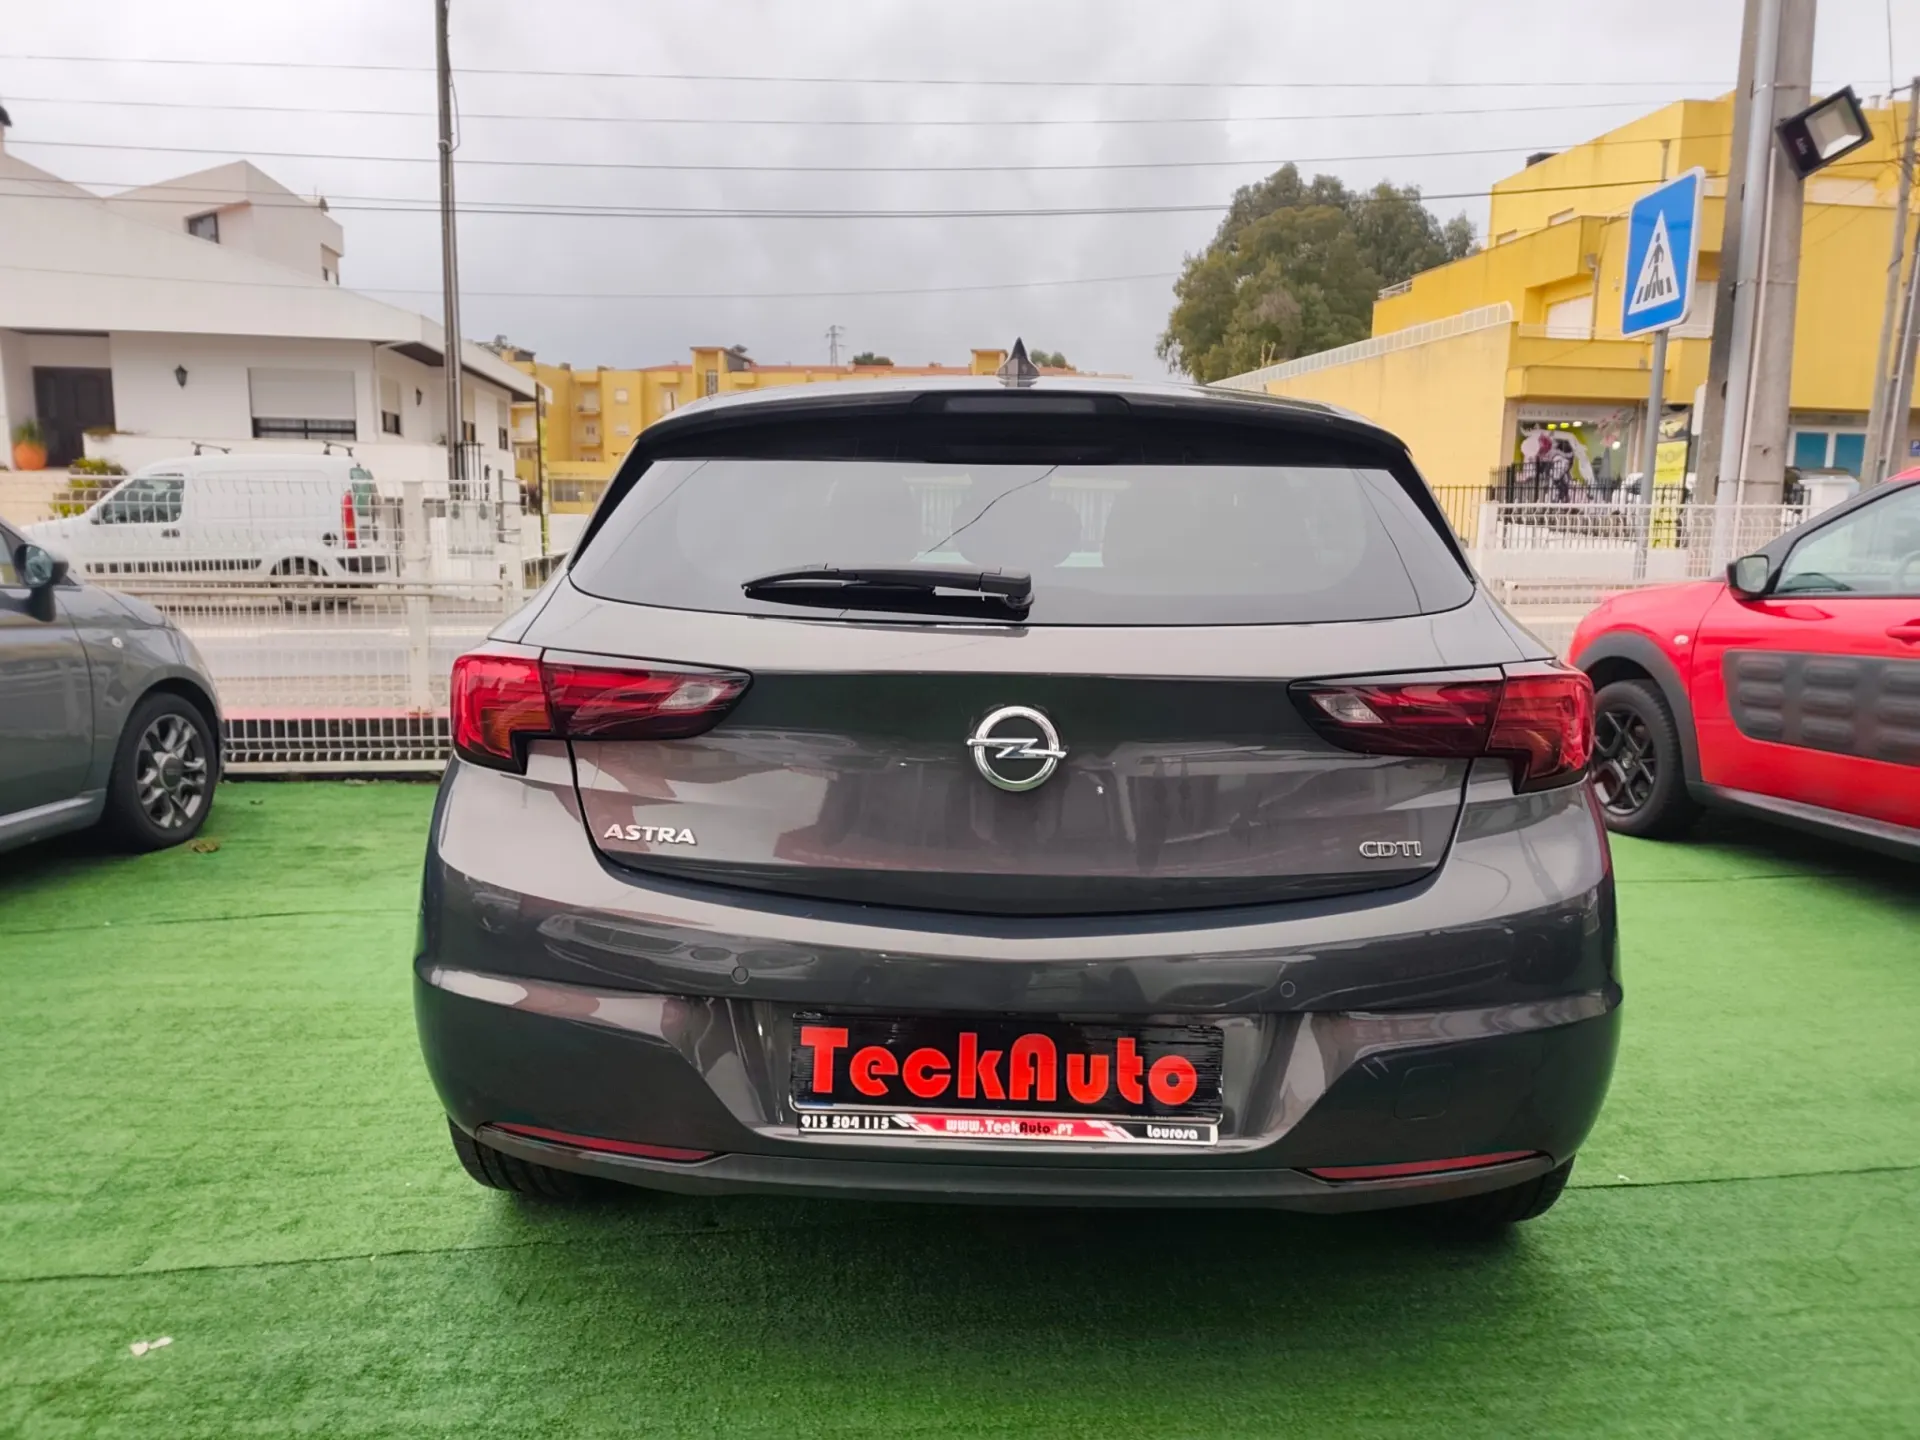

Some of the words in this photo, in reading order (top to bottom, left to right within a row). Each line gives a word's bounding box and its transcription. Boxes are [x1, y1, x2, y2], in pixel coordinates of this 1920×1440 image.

[603, 823, 696, 845] ASTRA
[1359, 840, 1422, 857] CDTI
[801, 1026, 1197, 1106] TeckAuto
[832, 1115, 859, 1129] 504
[864, 1116, 889, 1130] 115
[1146, 1124, 1198, 1140] Lourosa
